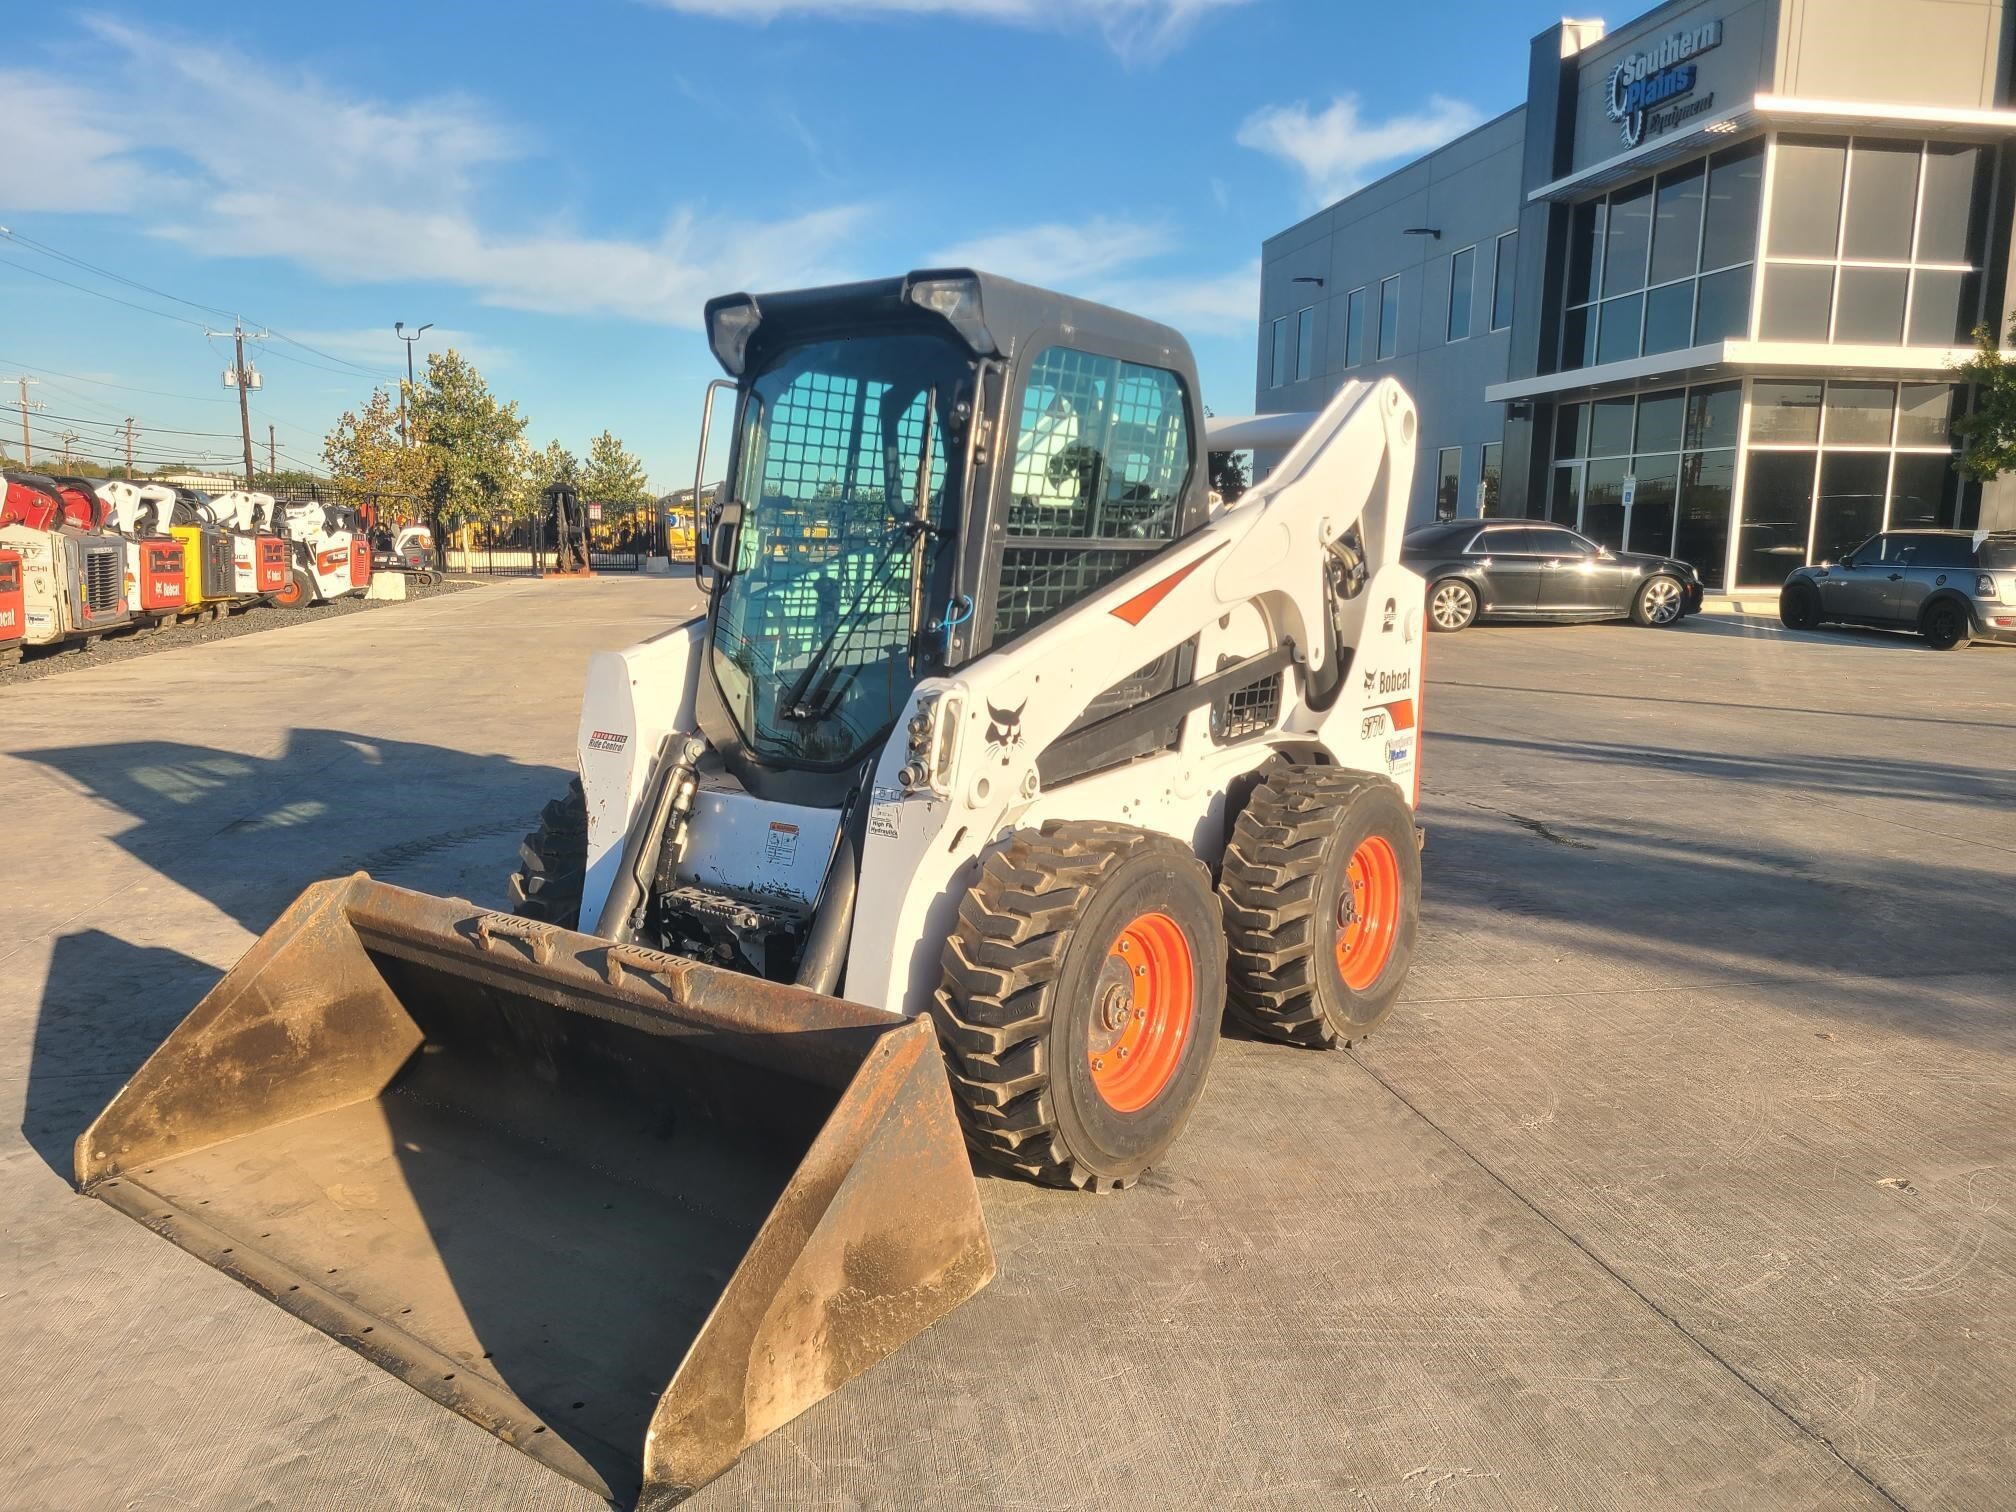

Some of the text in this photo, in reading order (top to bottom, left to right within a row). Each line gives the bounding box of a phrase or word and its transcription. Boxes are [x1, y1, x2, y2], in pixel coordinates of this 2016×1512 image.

[1623, 20, 1722, 85] Southern
[1625, 65, 1696, 114] Plains
[1651, 92, 1714, 133] Equipment
[1380, 668, 1411, 695] Bobcat
[592, 731, 628, 743] AUTOMATIC
[1361, 713, 1386, 741] S770
[589, 739, 625, 752] Ride Control
